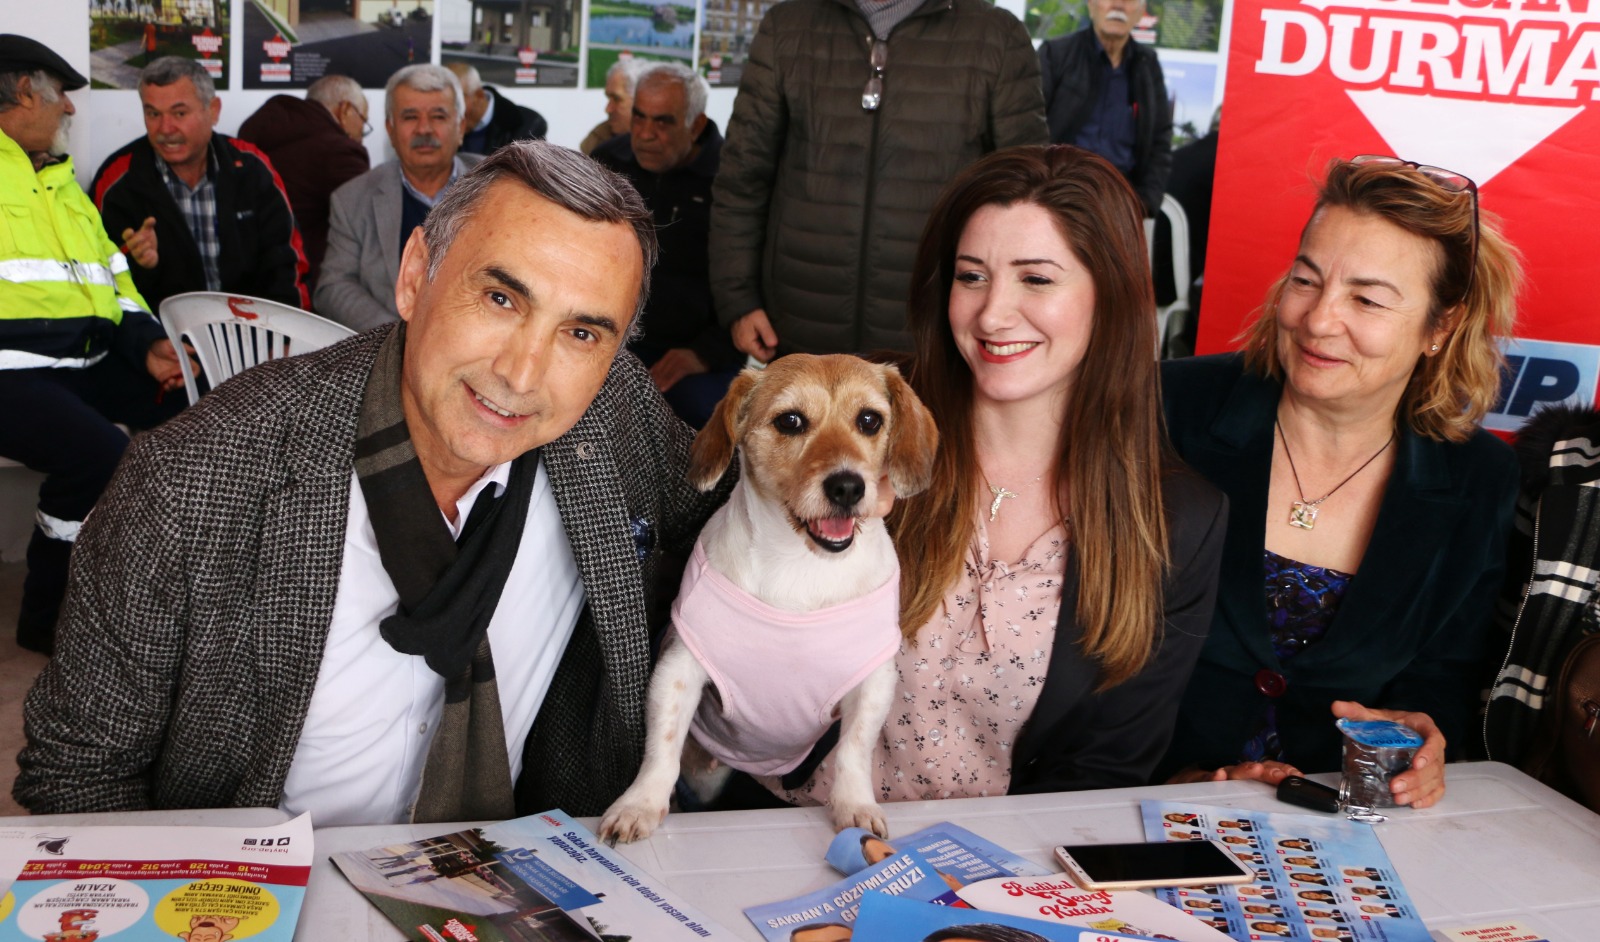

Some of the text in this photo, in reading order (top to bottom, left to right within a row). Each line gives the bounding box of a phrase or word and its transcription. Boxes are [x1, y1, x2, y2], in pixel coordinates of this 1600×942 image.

[241, 846, 288, 854] haytap.org
[547, 835, 589, 863] yapacağız.
[189, 882, 261, 895] ÖNÜNE GEÇER
[563, 832, 711, 938] Sokak hayvanları için doğal yaşam alanı
